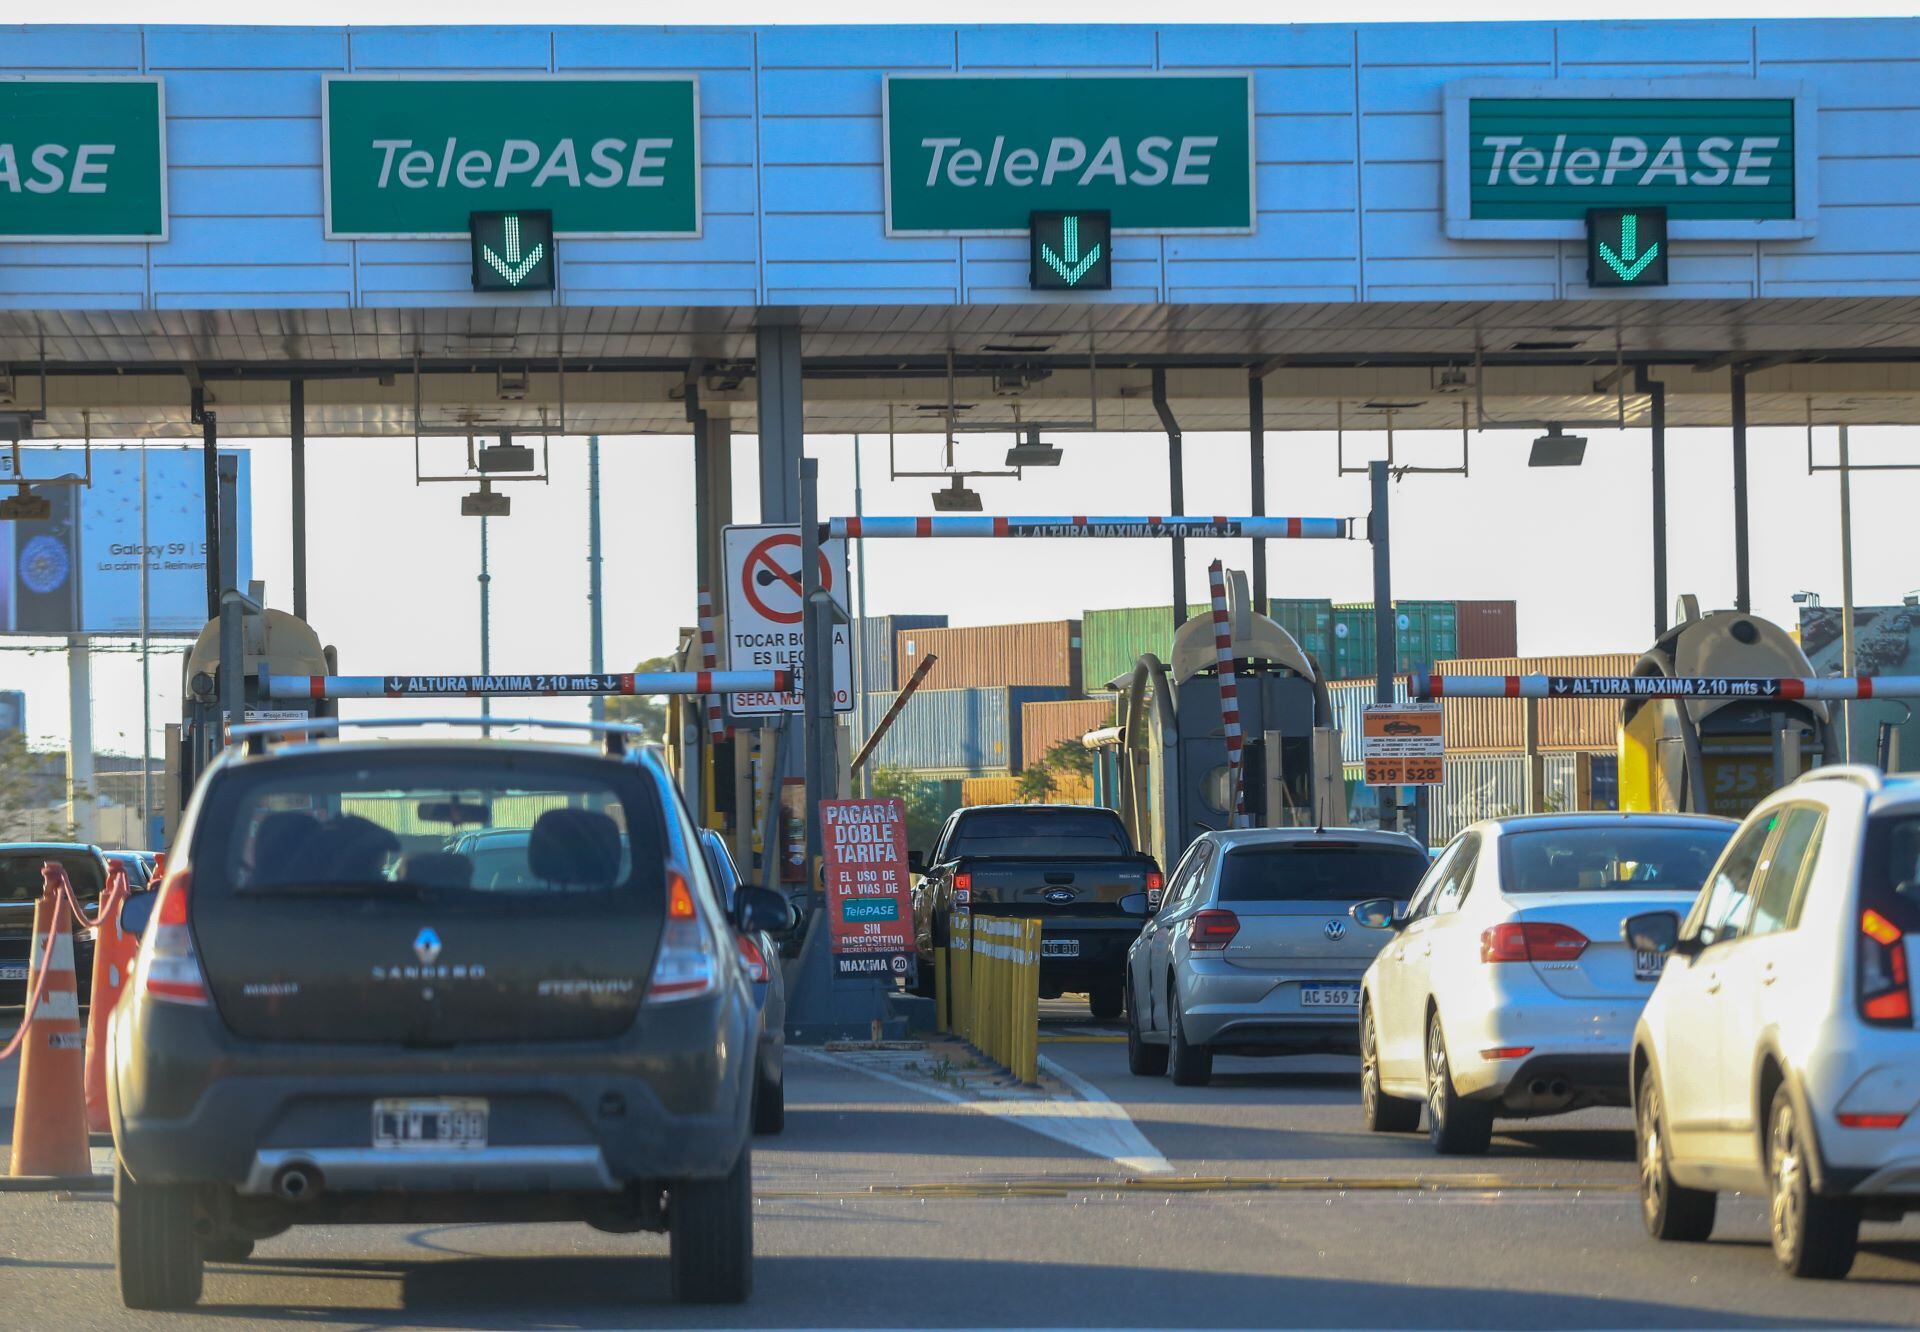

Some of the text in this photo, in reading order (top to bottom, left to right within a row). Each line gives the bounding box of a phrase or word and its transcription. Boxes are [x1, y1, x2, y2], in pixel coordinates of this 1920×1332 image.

[371, 136, 674, 189] TelePASE
[921, 136, 1219, 187] TelePASE
[1482, 134, 1780, 185] TelePASE
[1032, 523, 1218, 538] ALTURA MAXIMA 2.10 mts
[168, 543, 185, 555] S9
[735, 633, 785, 647] TOCAR
[753, 651, 772, 665] ES
[408, 675, 599, 691] ALTURA MAXIMA 2.10 mts
[1572, 679, 1759, 695] ALTURA MAXIMA 2.10 mts
[737, 692, 776, 707] SERA
[826, 800, 899, 825] PAGARÁ
[835, 823, 894, 844] DOBLE
[834, 843, 898, 863] TARIFA
[840, 870, 896, 882] EL USO DE
[839, 883, 899, 895] LA VIAS DE
[844, 905, 895, 917] TelePASE
[863, 923, 881, 935] SIN
[841, 935, 904, 947] DISPOSITIVO
[840, 959, 905, 972] MAXIMA 20
[1303, 990, 1321, 1004] AC
[1324, 990, 1348, 1004] 569
